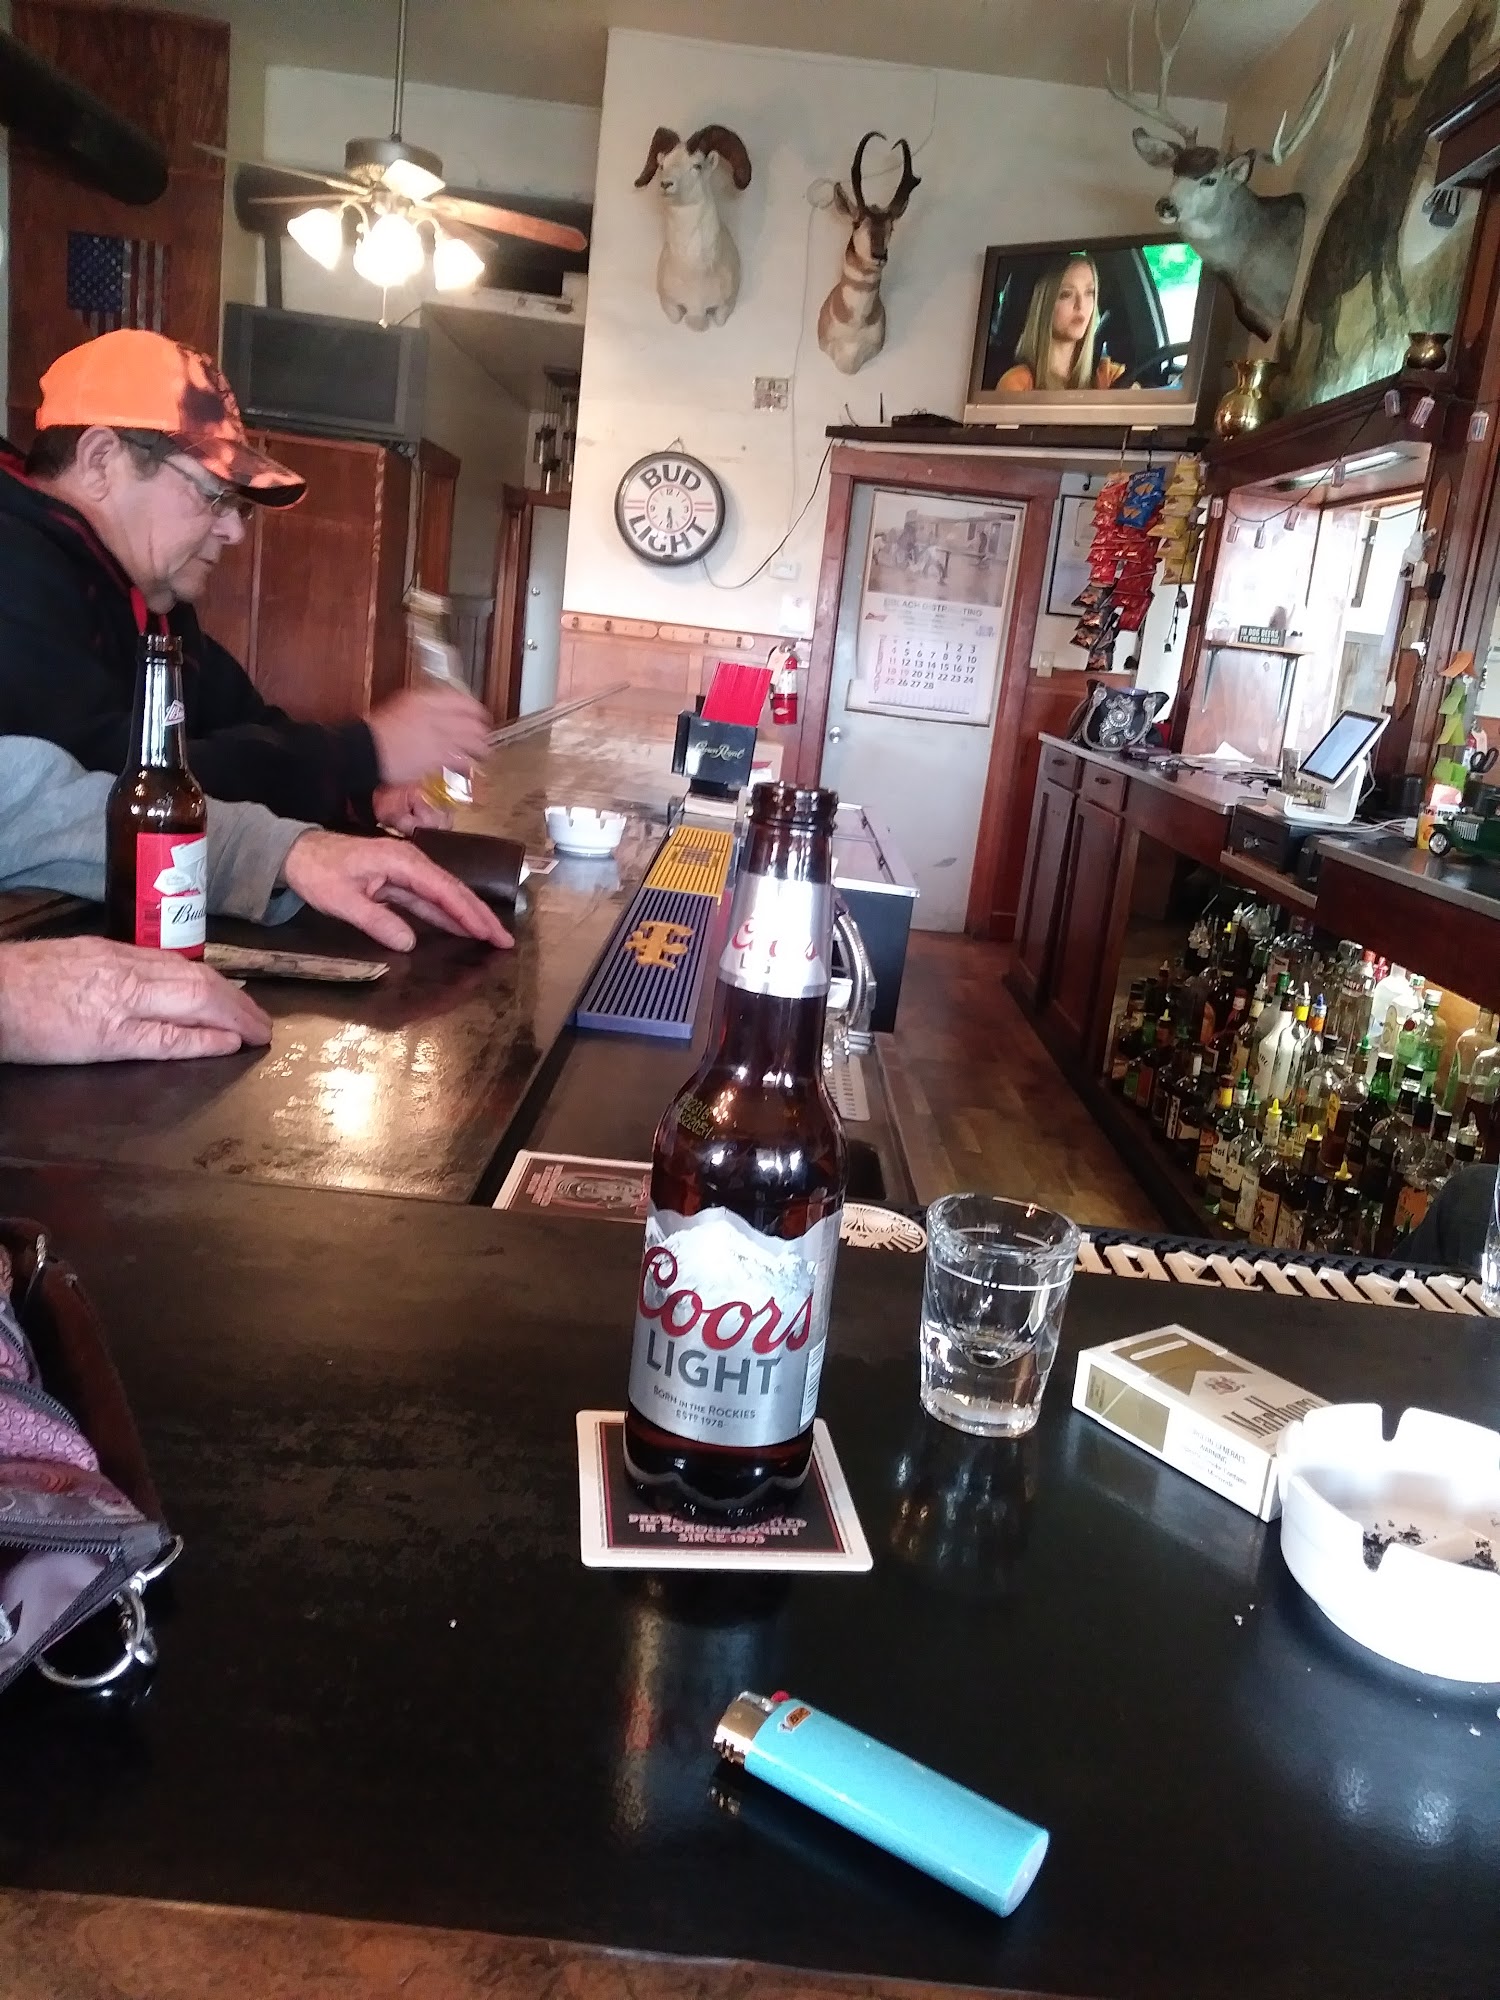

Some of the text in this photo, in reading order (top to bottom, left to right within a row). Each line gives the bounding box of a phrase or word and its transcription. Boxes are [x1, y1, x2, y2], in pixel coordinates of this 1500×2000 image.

[639, 464, 702, 491] BUD
[666, 488, 674, 496] 12
[628, 514, 707, 554] LIGHT
[904, 648, 910, 657] 5
[917, 650, 923, 658] 6
[930, 652, 936, 660] 7
[943, 653, 949, 661] 8
[956, 655, 962, 663] 9
[967, 655, 977, 664] 10
[957, 643, 963, 652] 2
[970, 645, 977, 654] 3
[889, 657, 976, 674] 11 12 13 14 15 16 17
[885, 677, 934, 690] 25 26 27 28
[887, 667, 974, 684] 18 19 20 21 22 23 24
[639, 1246, 814, 1355] Coors
[646, 1328, 783, 1396] LIGHT
[653, 1385, 756, 1420] BORN IN THE ROCKIES
[701, 1416, 724, 1429] 1978
